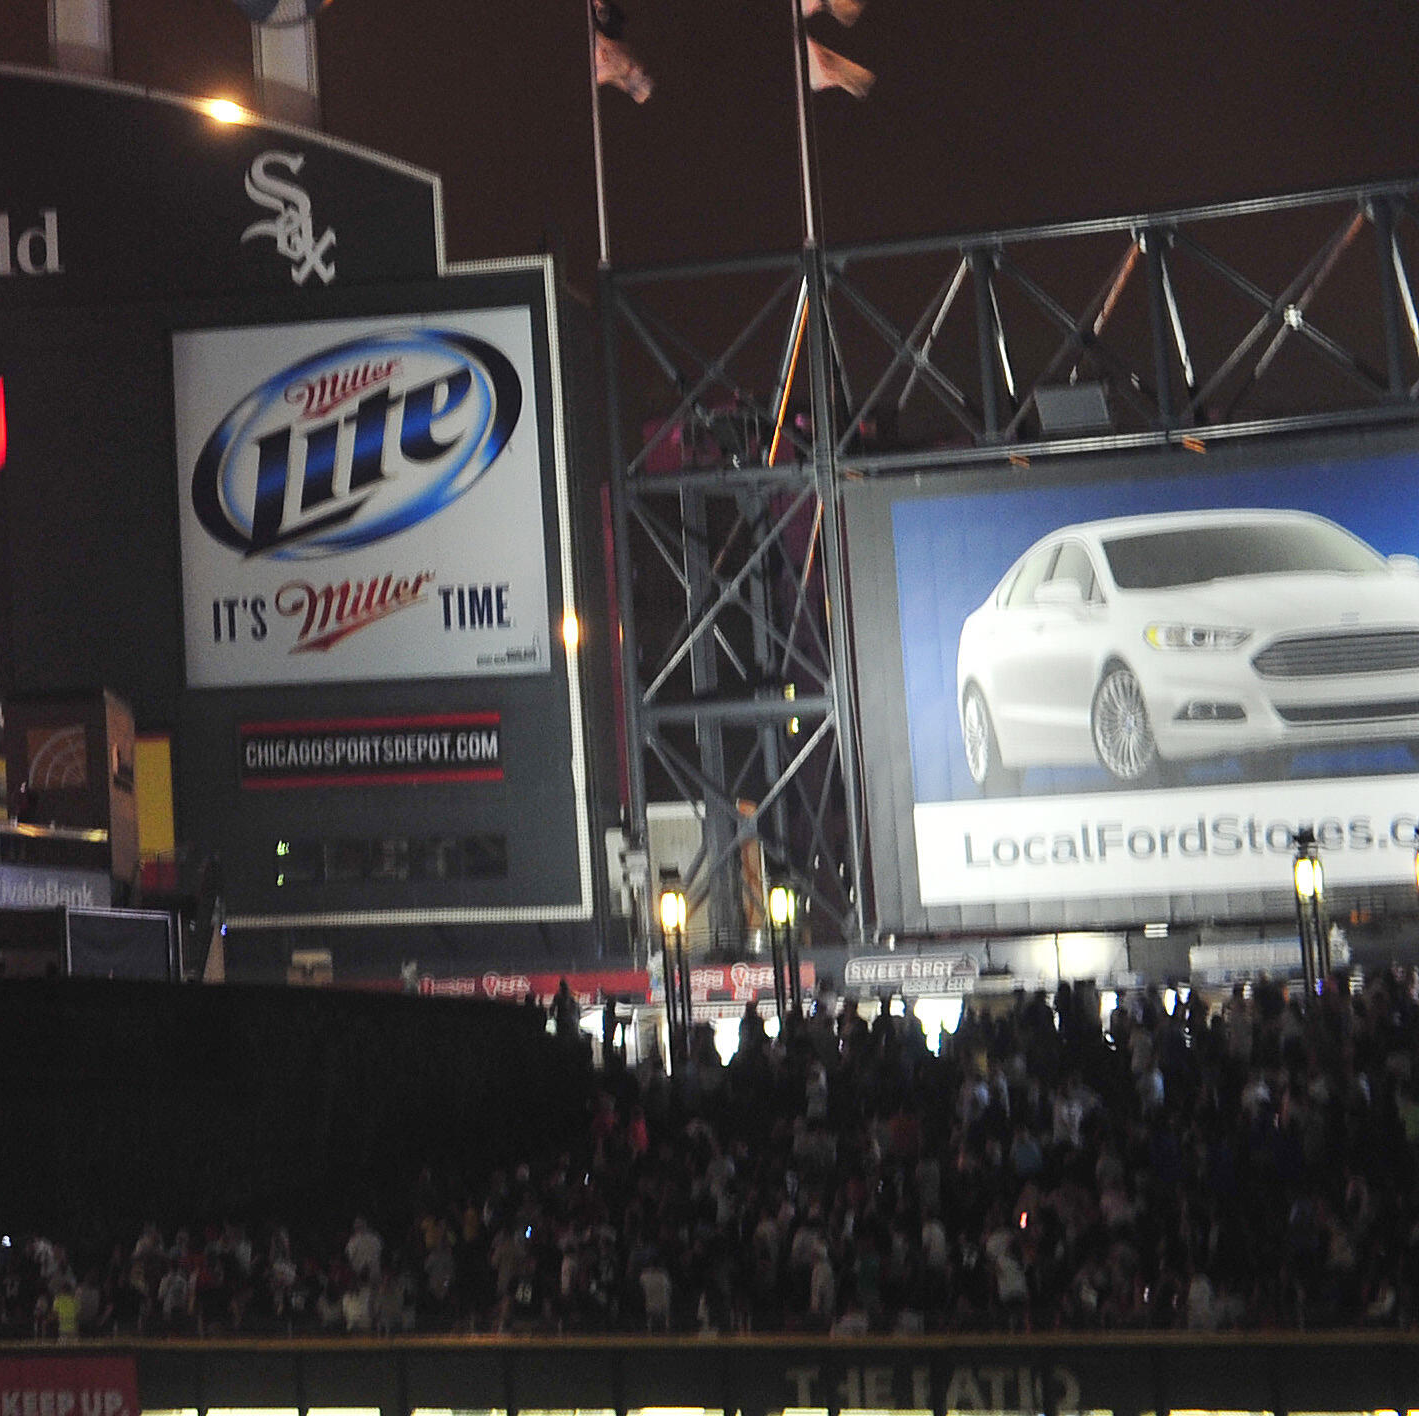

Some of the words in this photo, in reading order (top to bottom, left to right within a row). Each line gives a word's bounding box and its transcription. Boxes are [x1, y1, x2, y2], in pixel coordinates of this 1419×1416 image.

[241, 151, 337, 285] Sox
[285, 357, 403, 417] Miller
[247, 366, 473, 555] Lite
[213, 597, 268, 644] IT'S
[274, 569, 436, 653] Miller
[438, 584, 512, 632] TIME
[245, 732, 500, 767] CHICAGOSPORTSDEPOT.COM
[963, 810, 1419, 868] LocalFordStoes.c
[852, 963, 907, 979] SWEET
